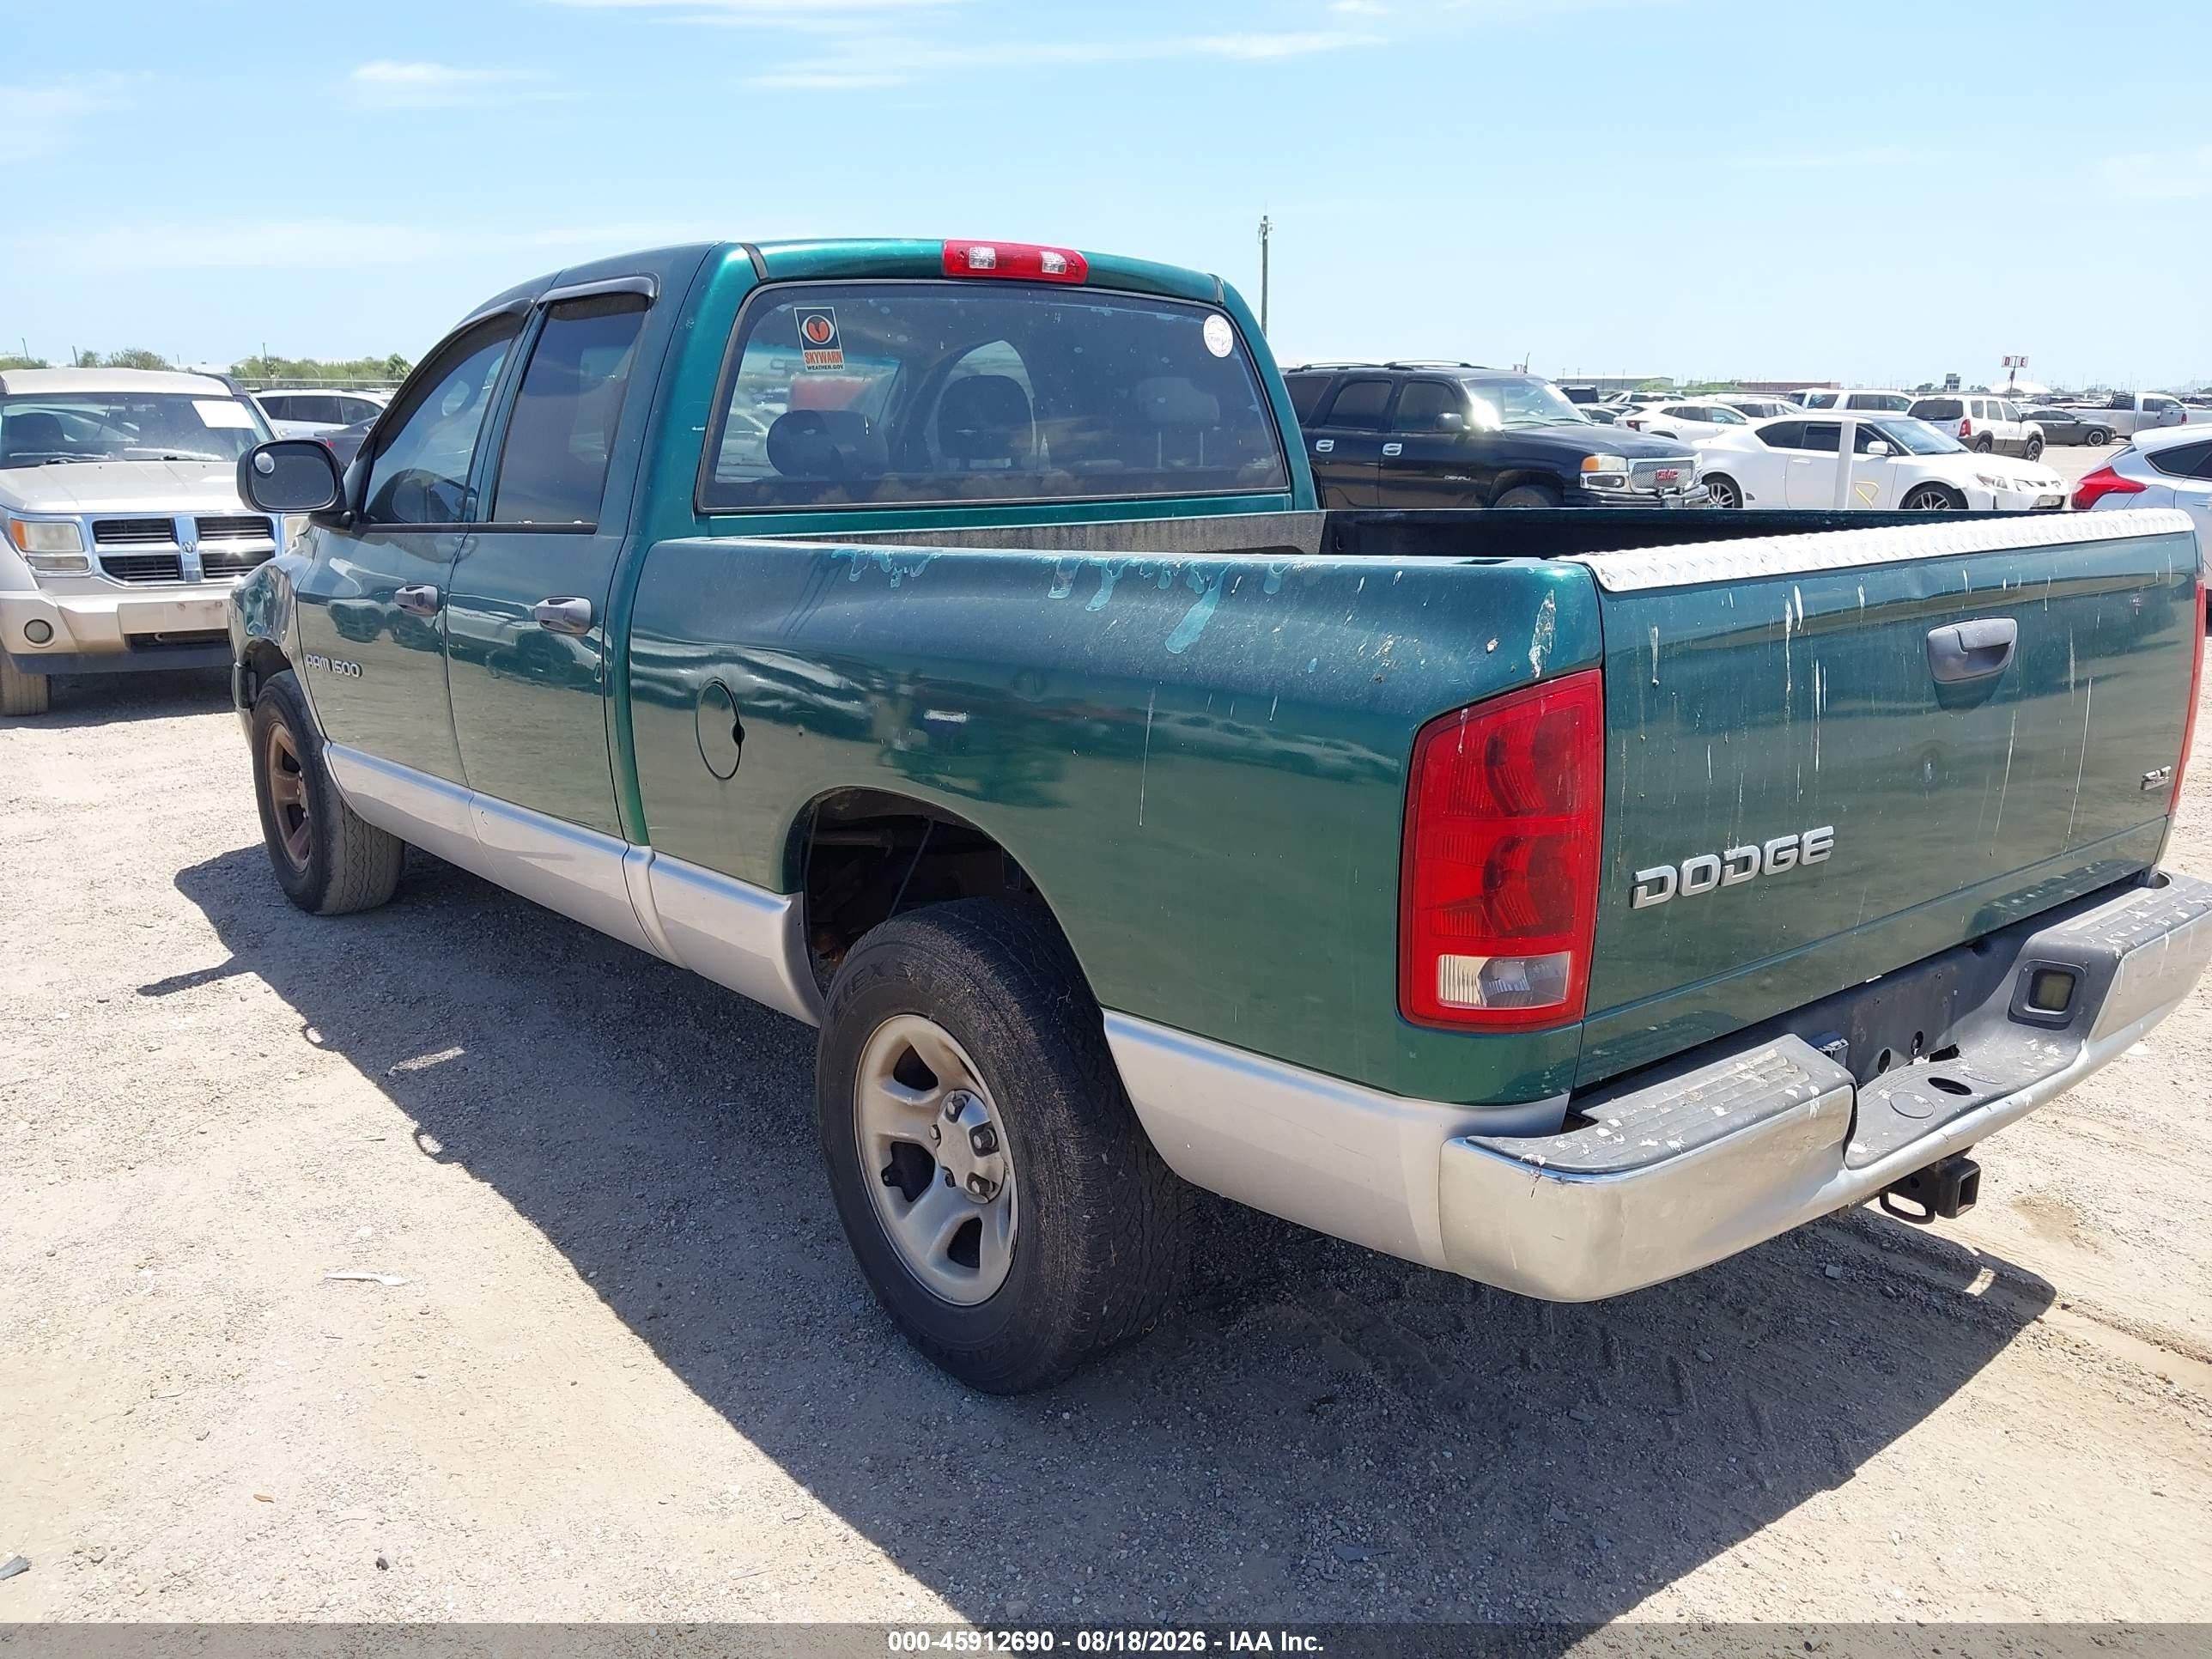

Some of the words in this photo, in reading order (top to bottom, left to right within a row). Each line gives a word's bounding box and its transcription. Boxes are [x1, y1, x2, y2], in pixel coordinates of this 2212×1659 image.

[805, 350, 842, 364] SKYWARN
[1656, 469, 1678, 480] GMC
[306, 653, 331, 672] RAM
[331, 659, 362, 678] 1500
[1630, 825, 1834, 909] DODGE
